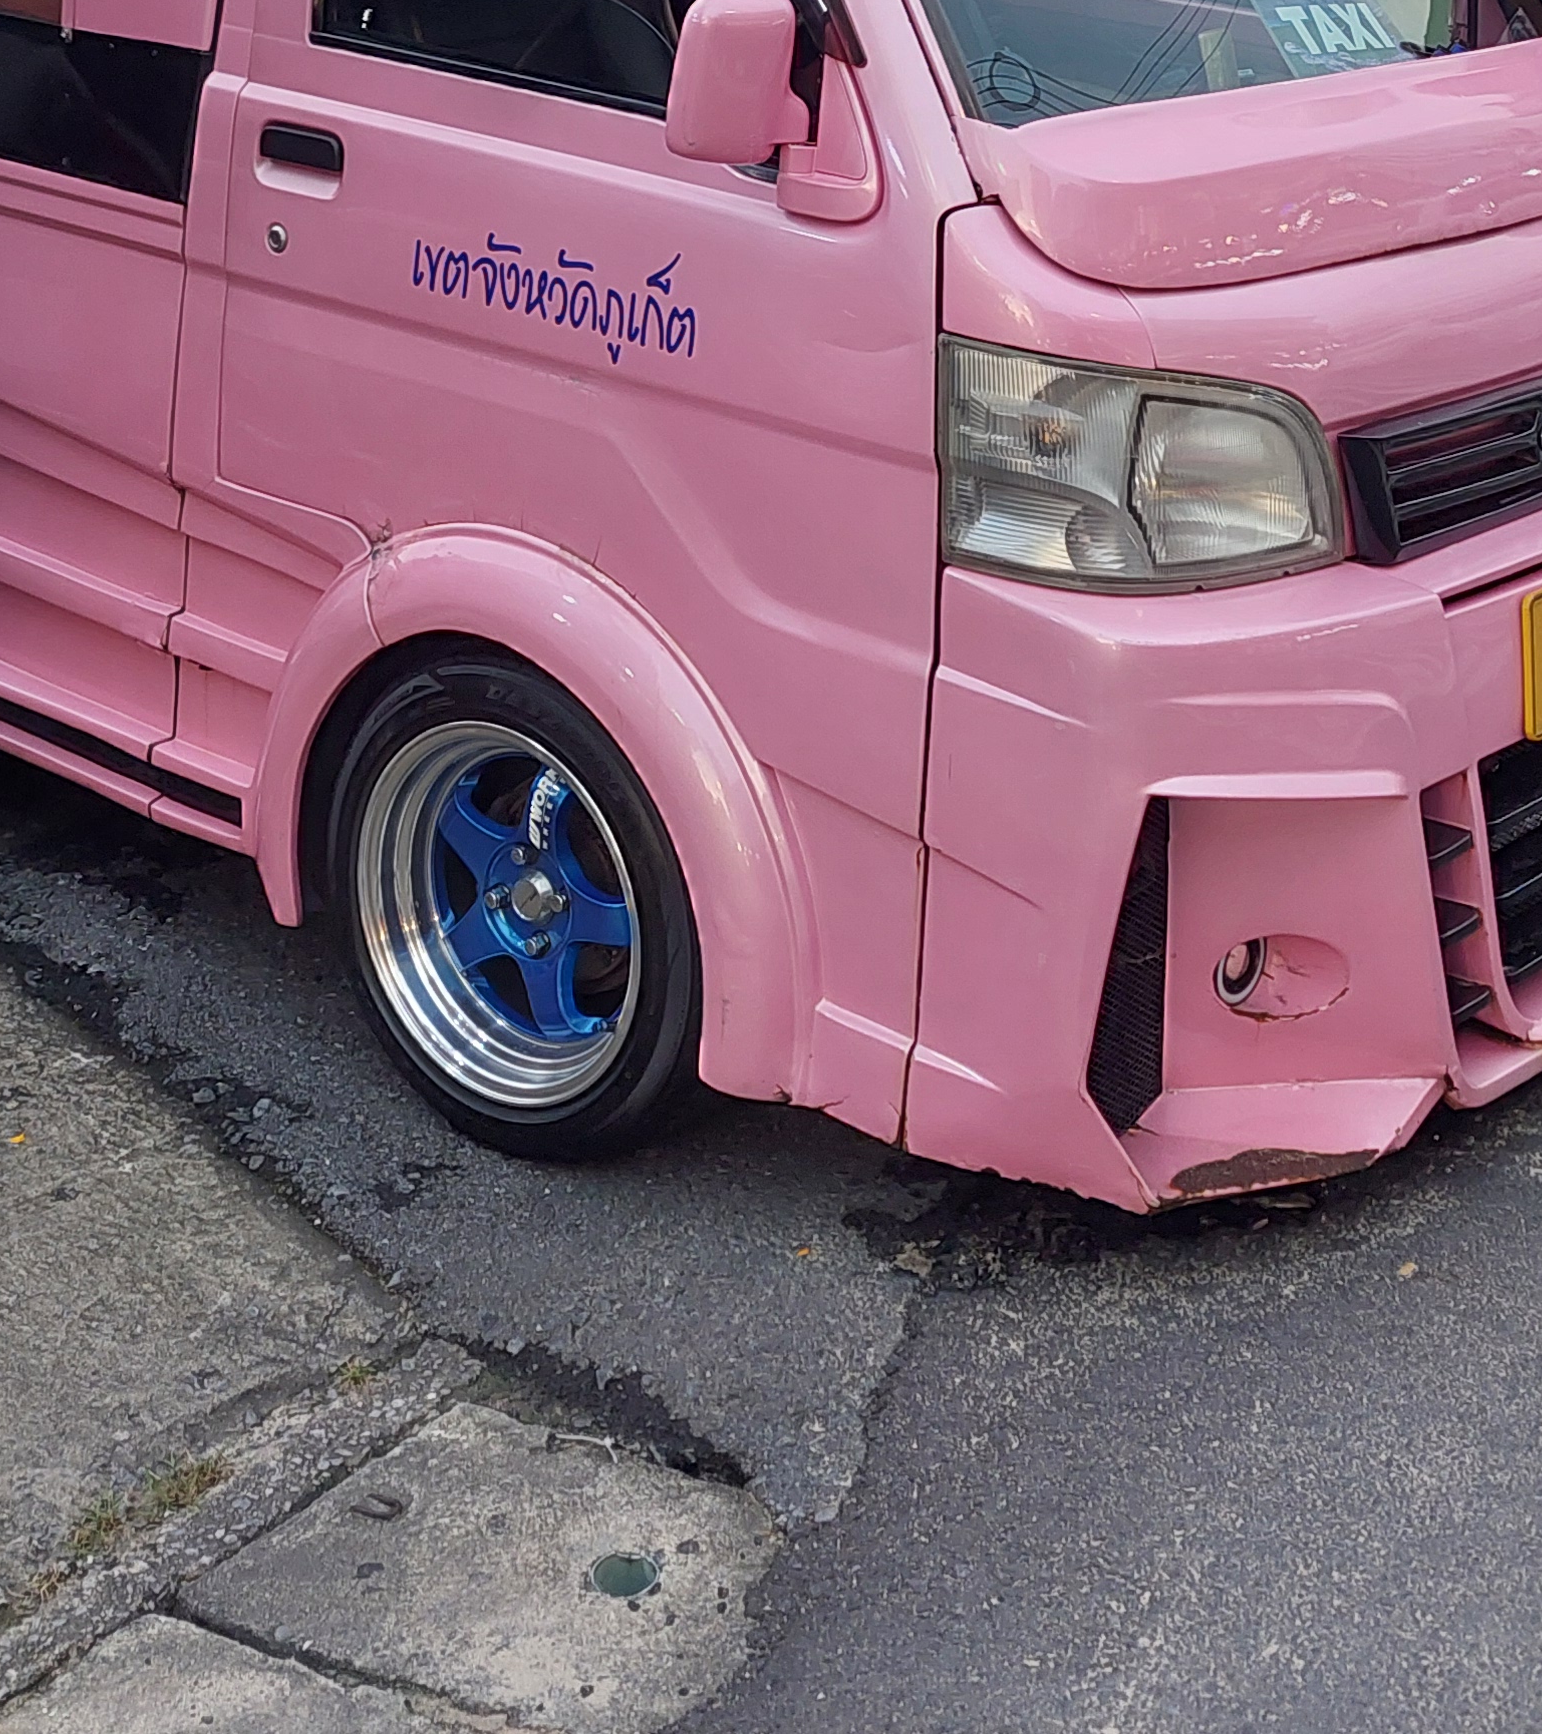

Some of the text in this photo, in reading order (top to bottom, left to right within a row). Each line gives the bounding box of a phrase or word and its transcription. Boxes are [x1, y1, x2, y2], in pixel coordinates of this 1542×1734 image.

[1274, 2, 1397, 55] TAXI
[412, 231, 697, 365] เขตจังหวัดภูเก็ต
